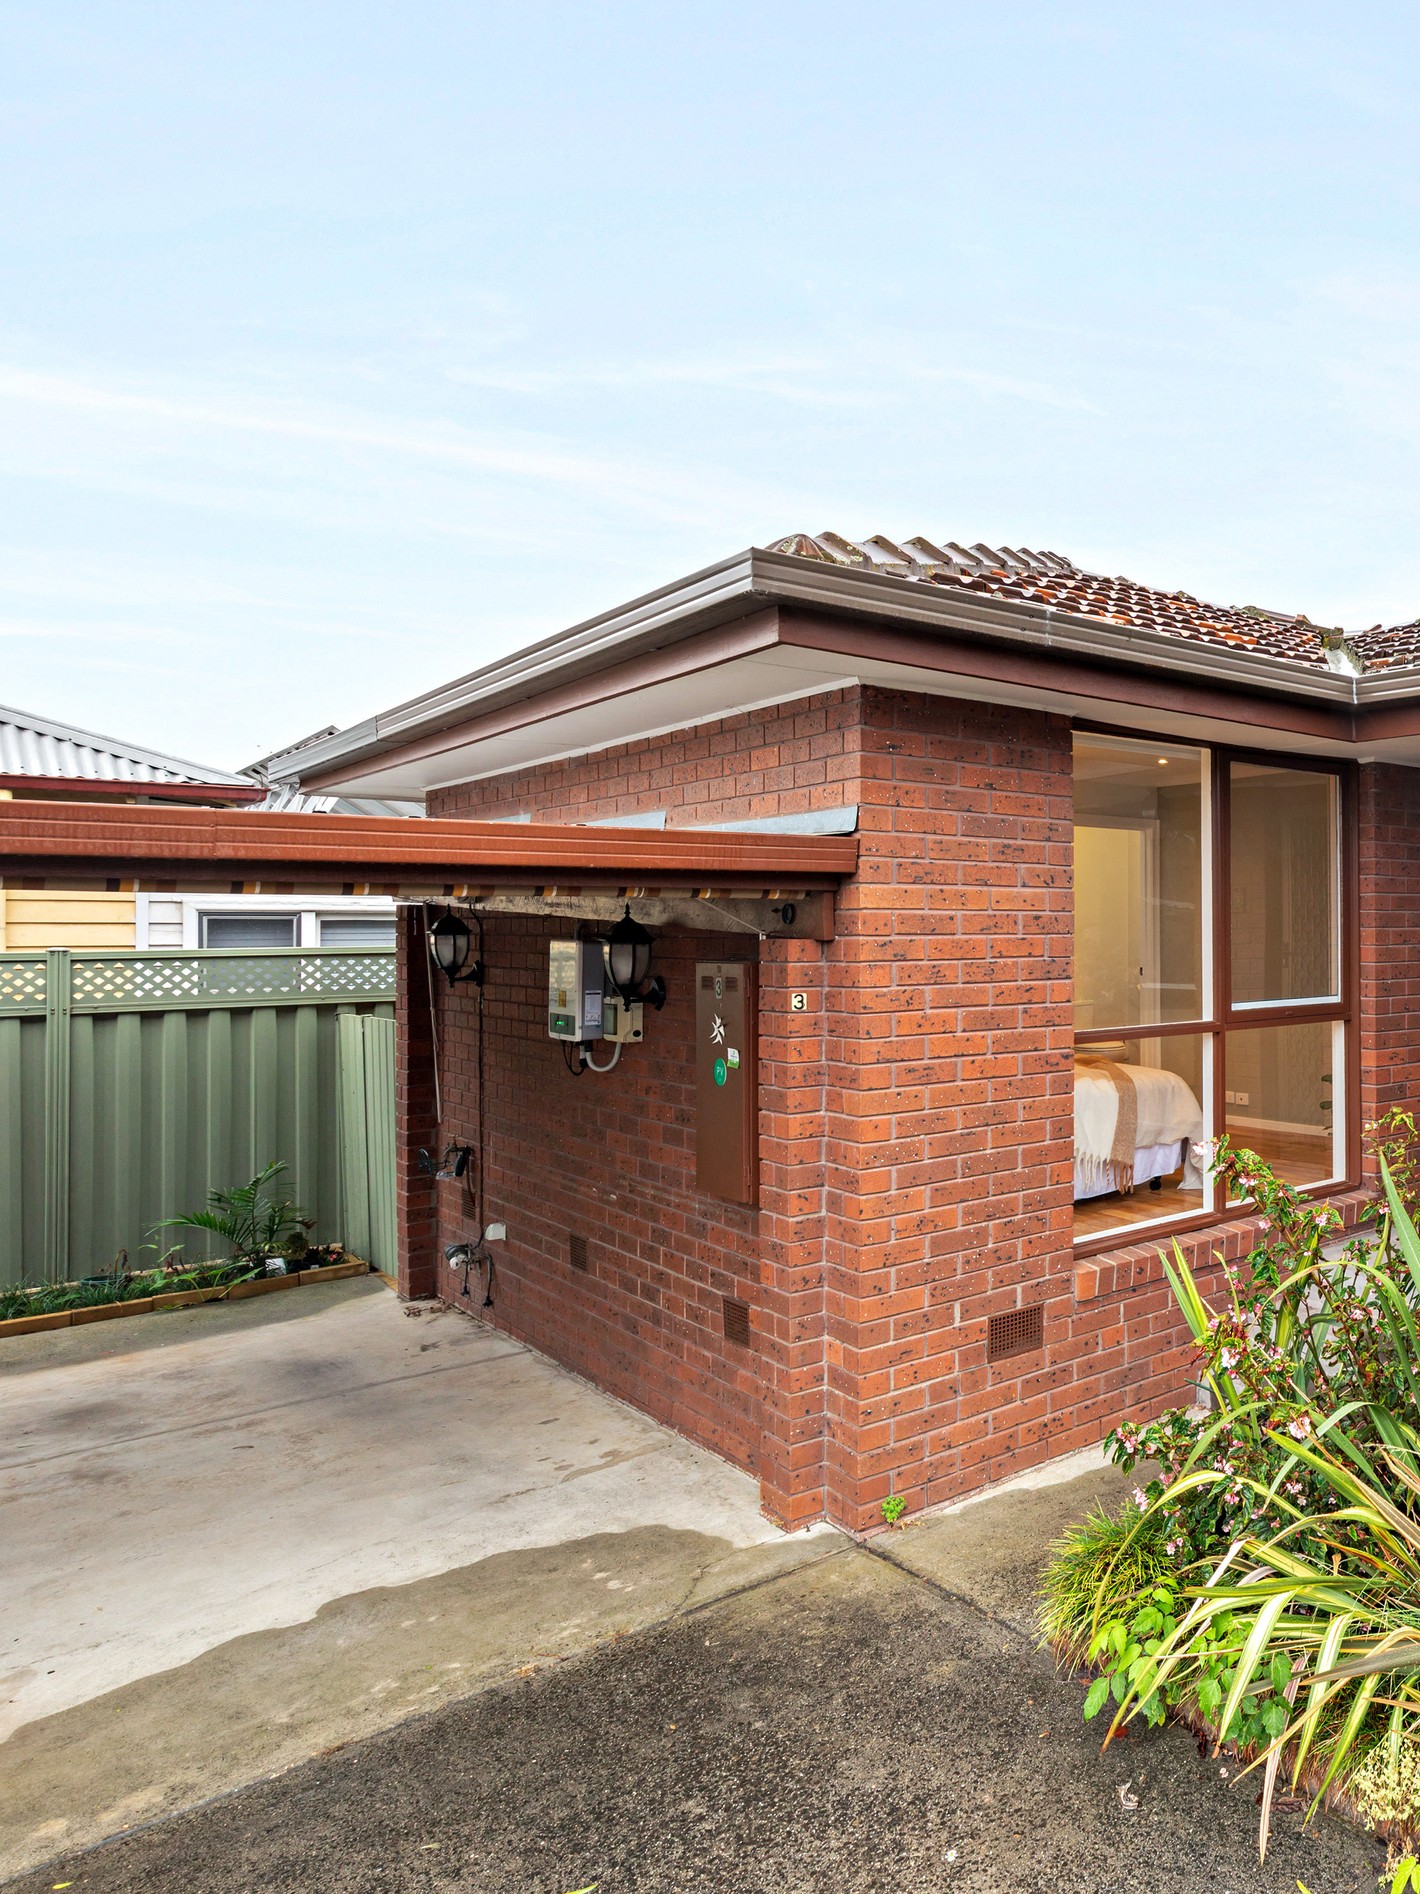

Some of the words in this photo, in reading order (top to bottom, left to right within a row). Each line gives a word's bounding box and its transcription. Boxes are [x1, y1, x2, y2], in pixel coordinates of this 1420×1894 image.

[716, 979, 722, 997] 3
[793, 993, 805, 1010] 3
[716, 1066, 724, 1077] PV
